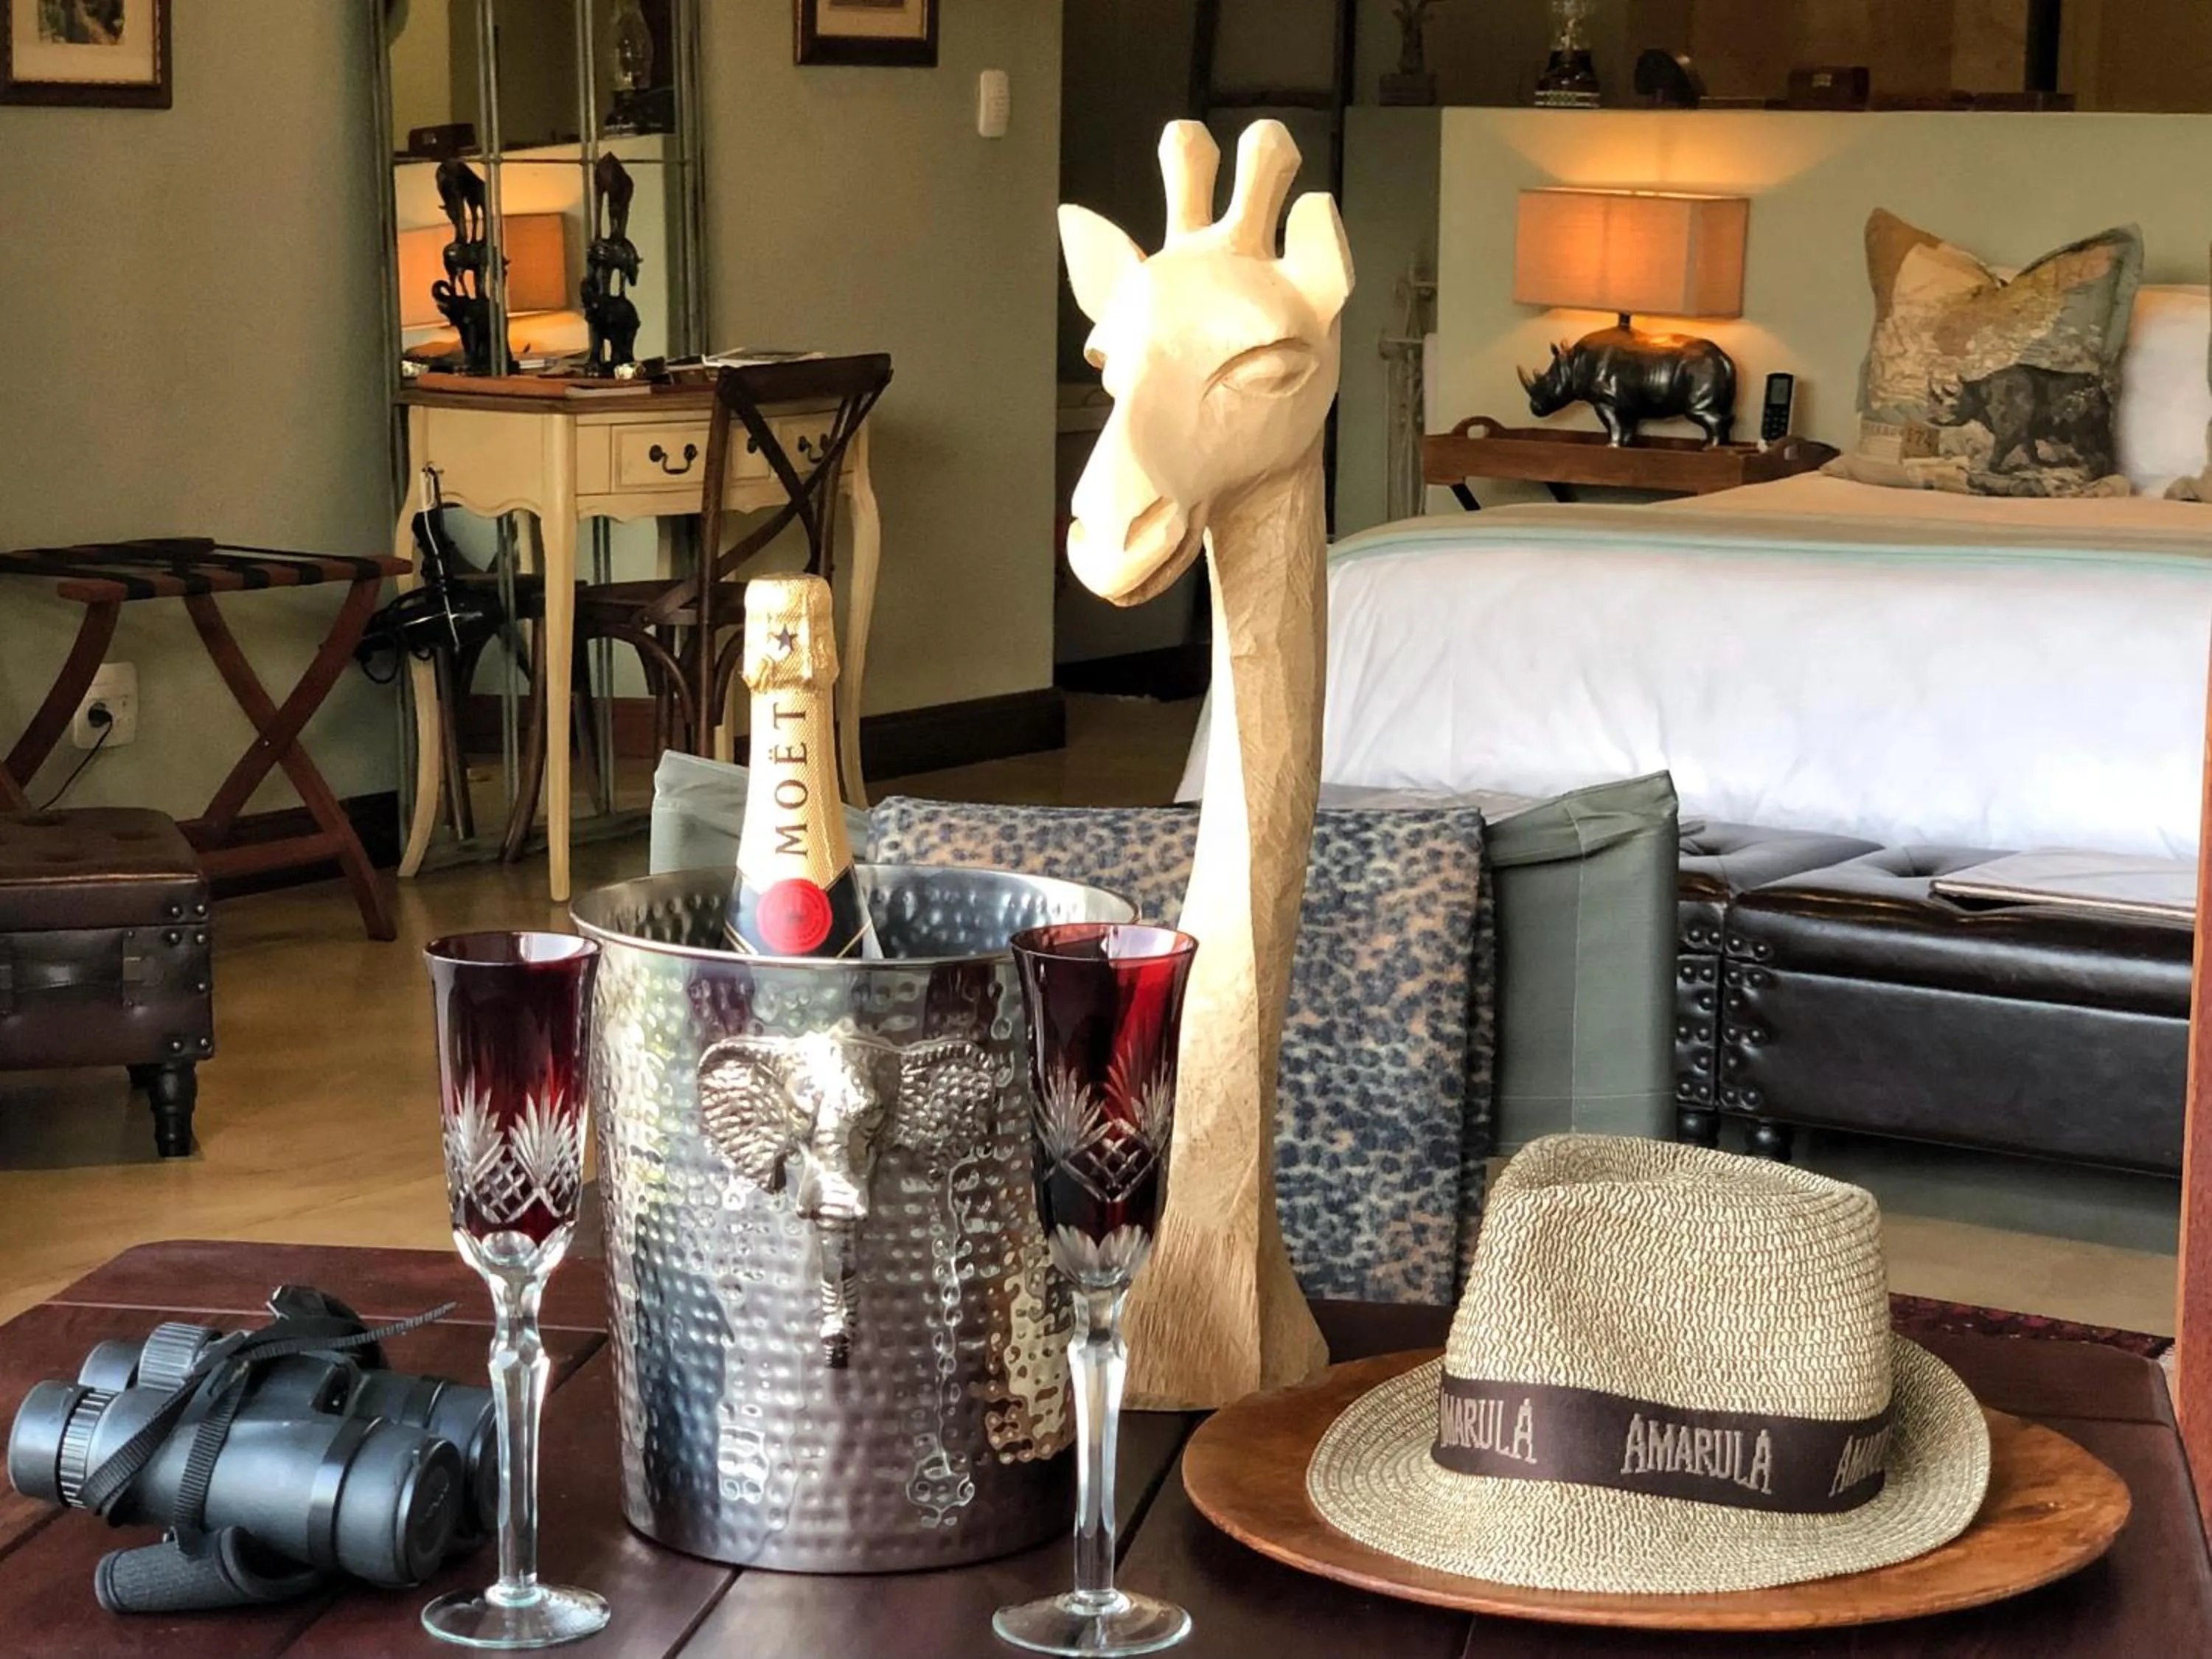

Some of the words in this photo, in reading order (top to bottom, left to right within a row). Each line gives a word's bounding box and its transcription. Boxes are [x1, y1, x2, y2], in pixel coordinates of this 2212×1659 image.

[768, 702, 809, 858] MOËT
[1440, 1385, 1538, 1464] MARULA
[1620, 1412, 1773, 1495] AMARULA
